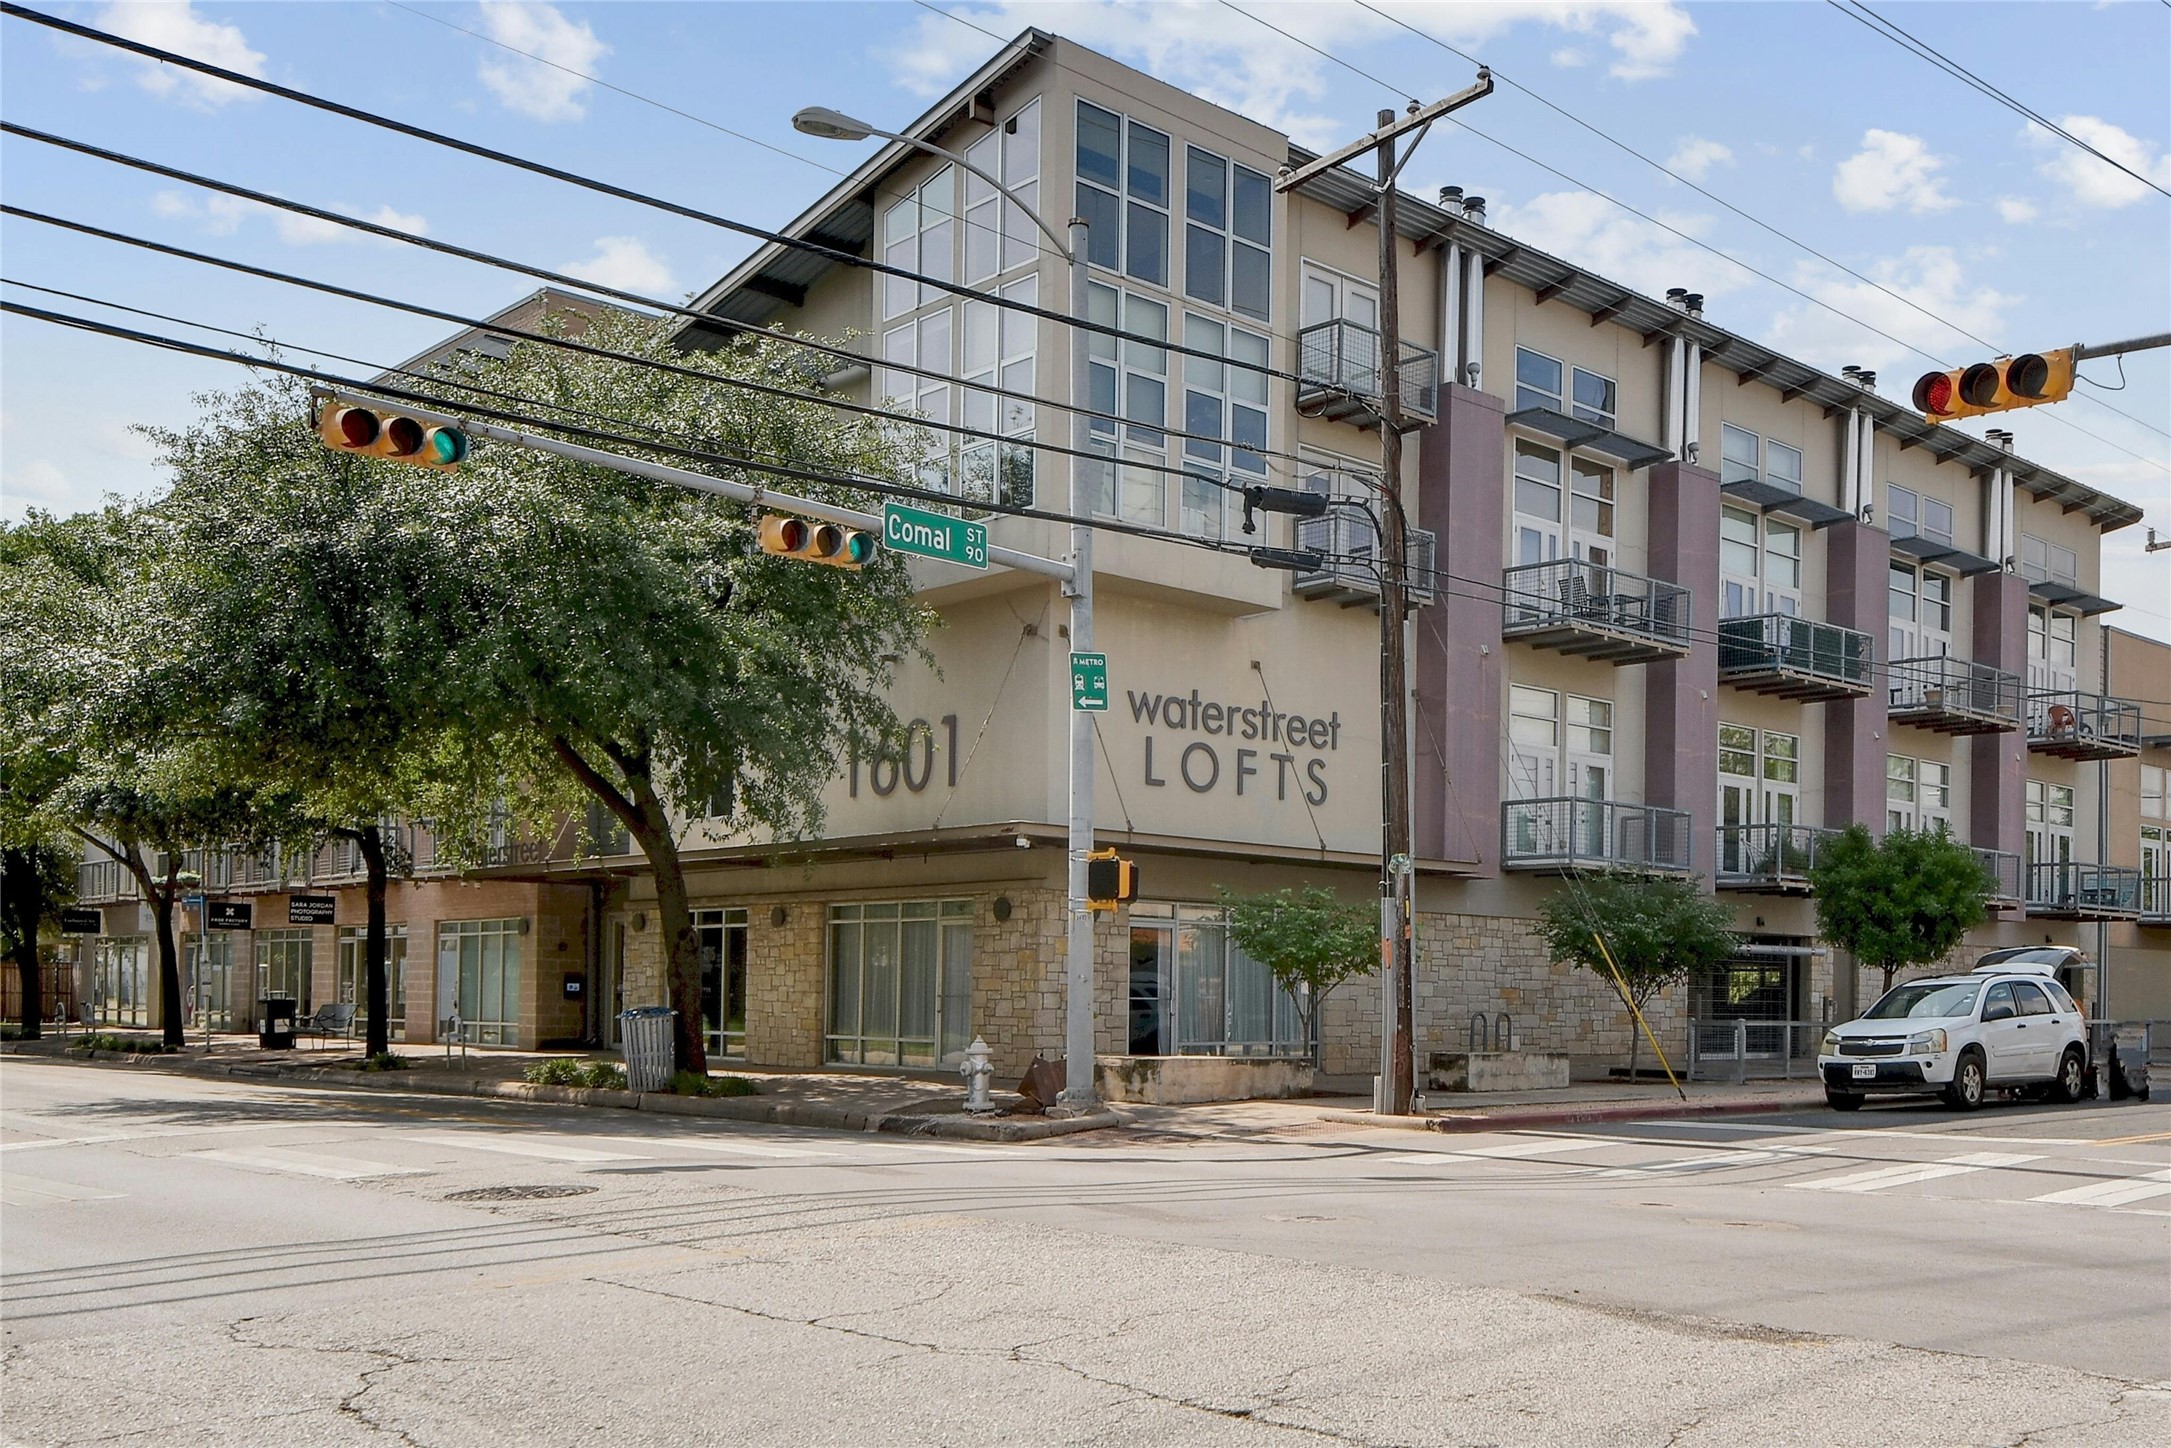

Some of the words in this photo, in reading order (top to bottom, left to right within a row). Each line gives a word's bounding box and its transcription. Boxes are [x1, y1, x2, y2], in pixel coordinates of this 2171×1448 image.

[889, 514, 951, 551] Comal
[966, 527, 984, 544] ST
[965, 546, 984, 562] 90
[1079, 658, 1104, 666] METRO
[1127, 689, 1342, 751] waterstreet
[1145, 735, 1328, 806] LOFTS
[290, 908, 334, 916] PHOTOGRAPHY
